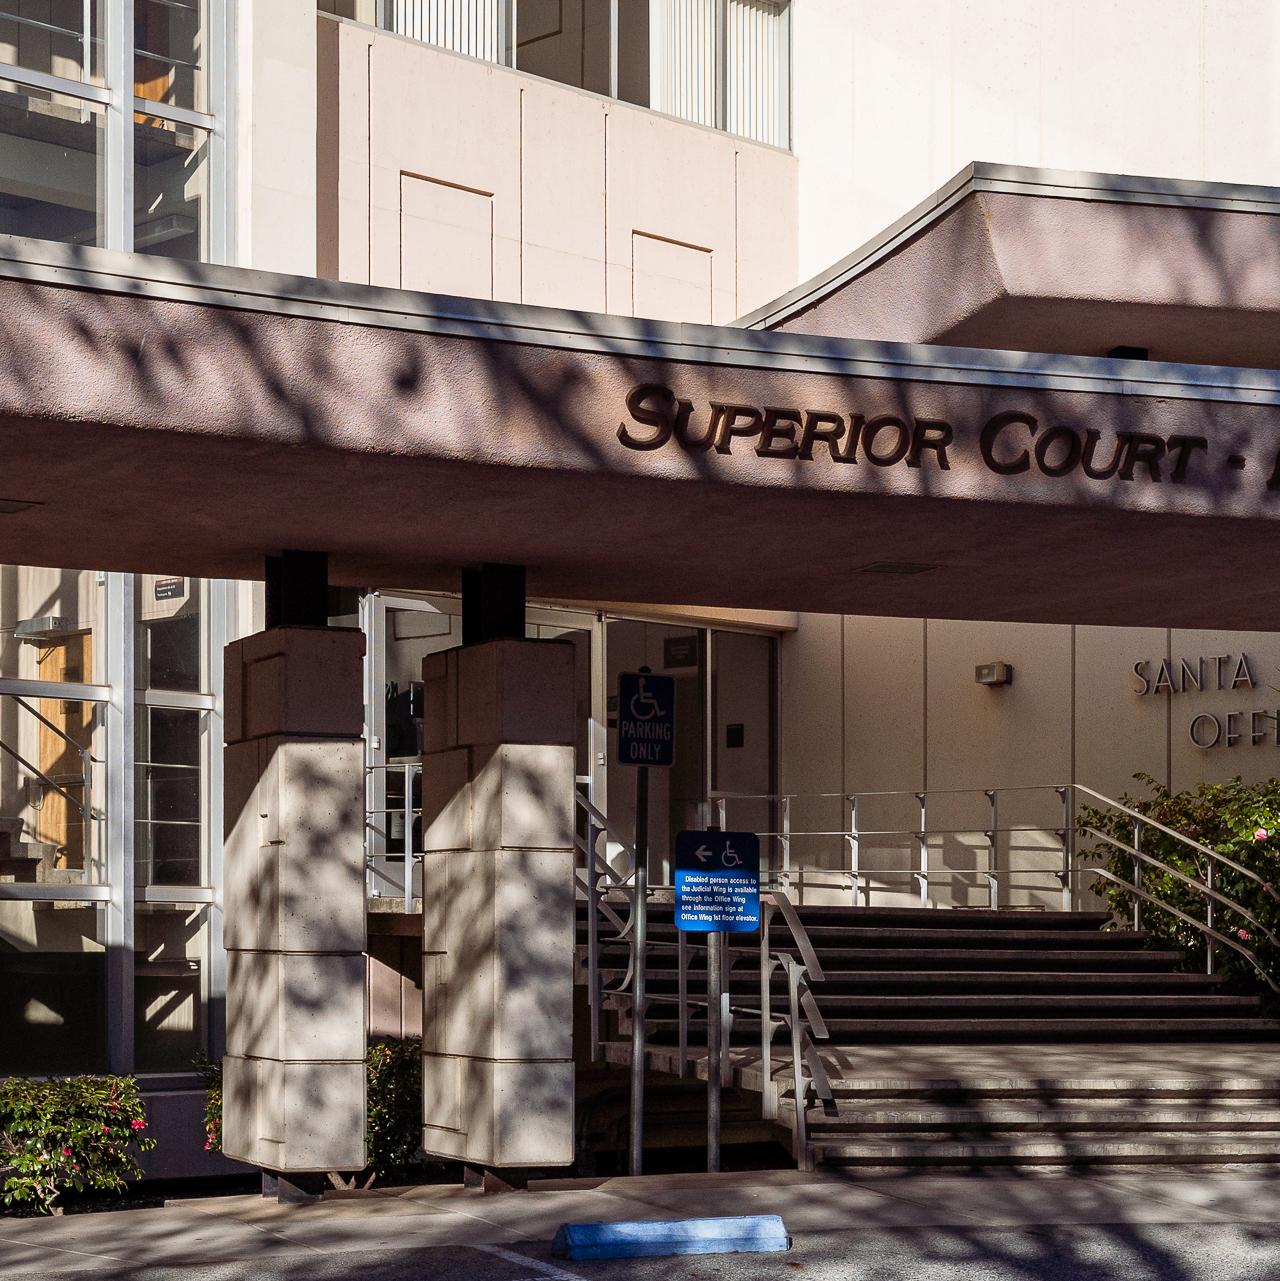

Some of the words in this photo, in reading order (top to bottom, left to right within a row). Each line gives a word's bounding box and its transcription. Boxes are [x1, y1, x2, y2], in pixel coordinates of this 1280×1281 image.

[617, 384, 953, 470] SUPERIOR
[979, 410, 1208, 482] COURT
[1133, 653, 1256, 696] SANTA
[622, 721, 671, 741] PARKING
[630, 742, 661, 760] ONLY
[682, 895, 702, 903] through
